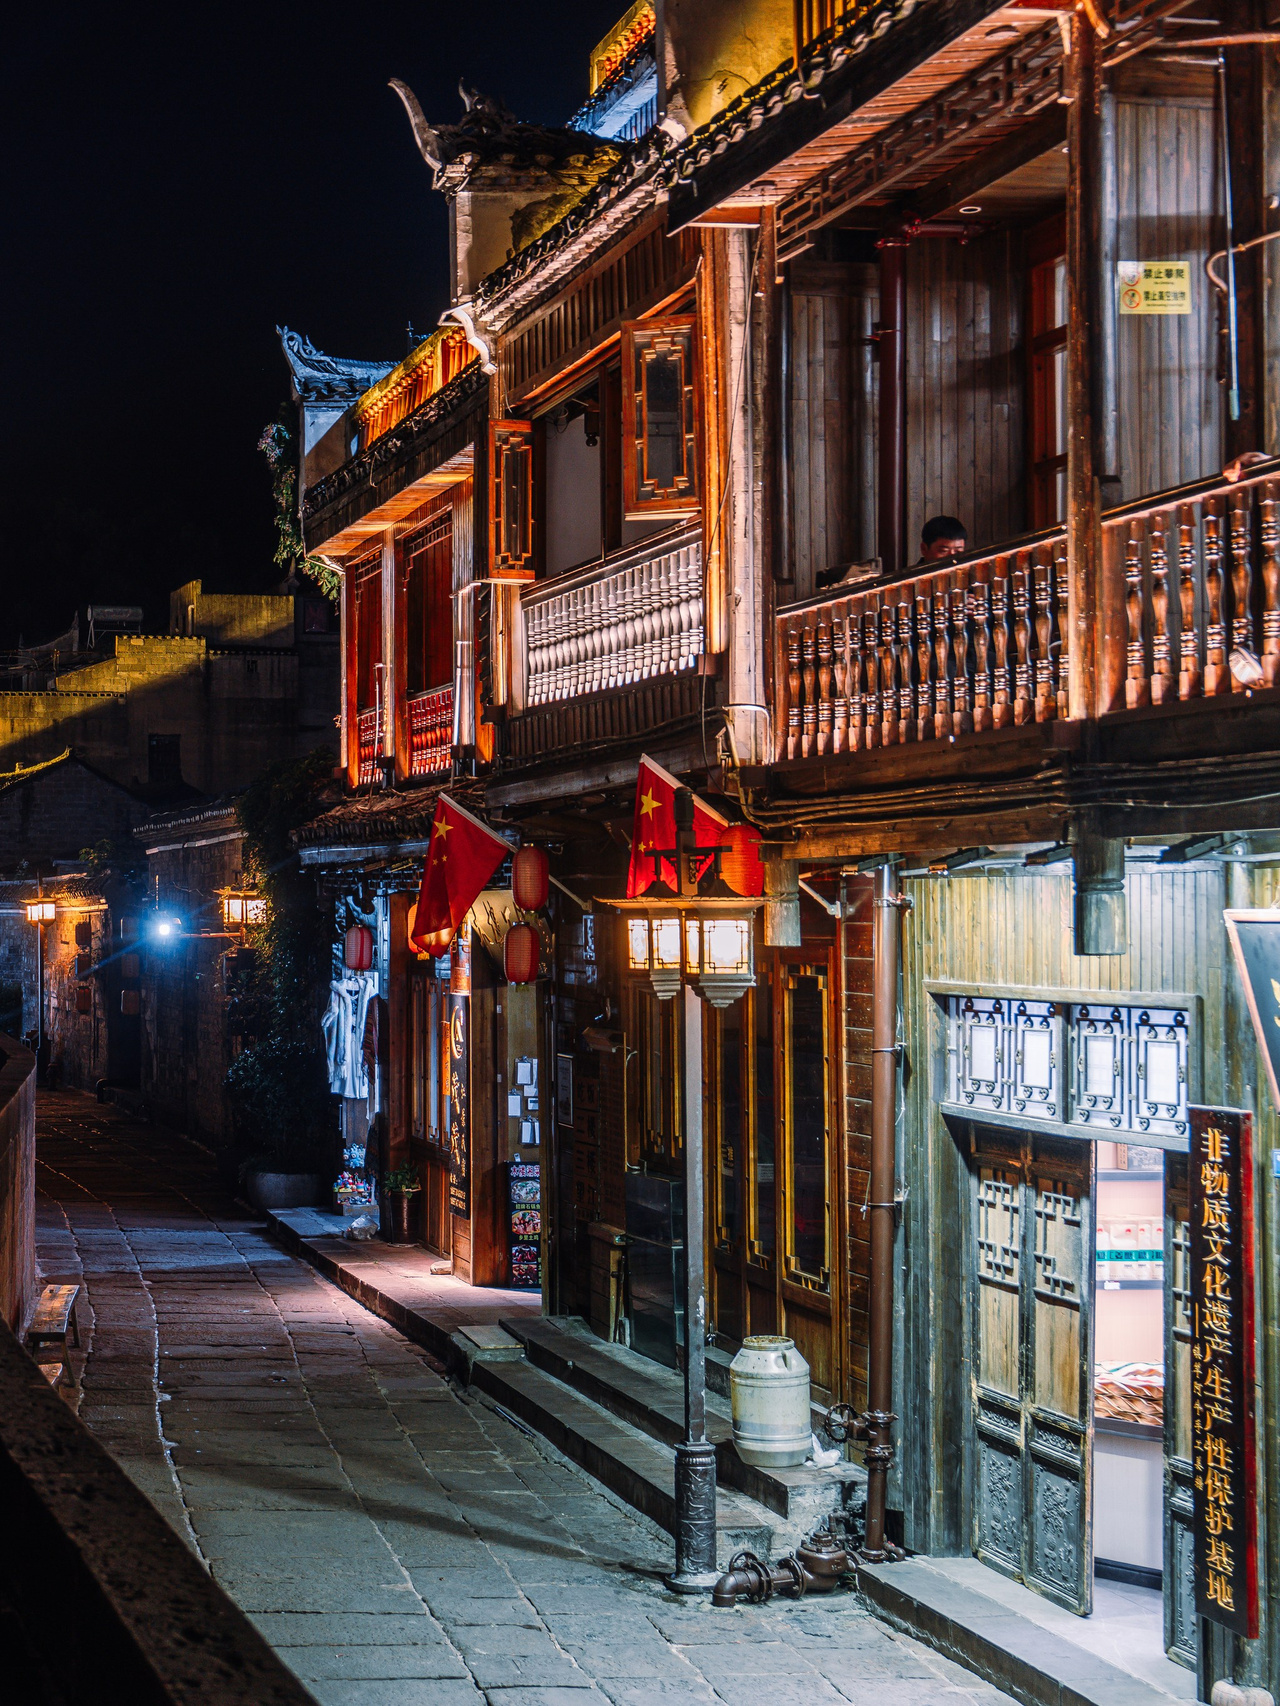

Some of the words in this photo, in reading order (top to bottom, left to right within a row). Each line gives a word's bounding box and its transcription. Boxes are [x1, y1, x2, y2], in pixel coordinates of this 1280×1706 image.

[1144, 269, 1184, 279] 禁止攀爬
[1201, 1127, 1235, 1611] 非物质文化遗产生产性保护基地
